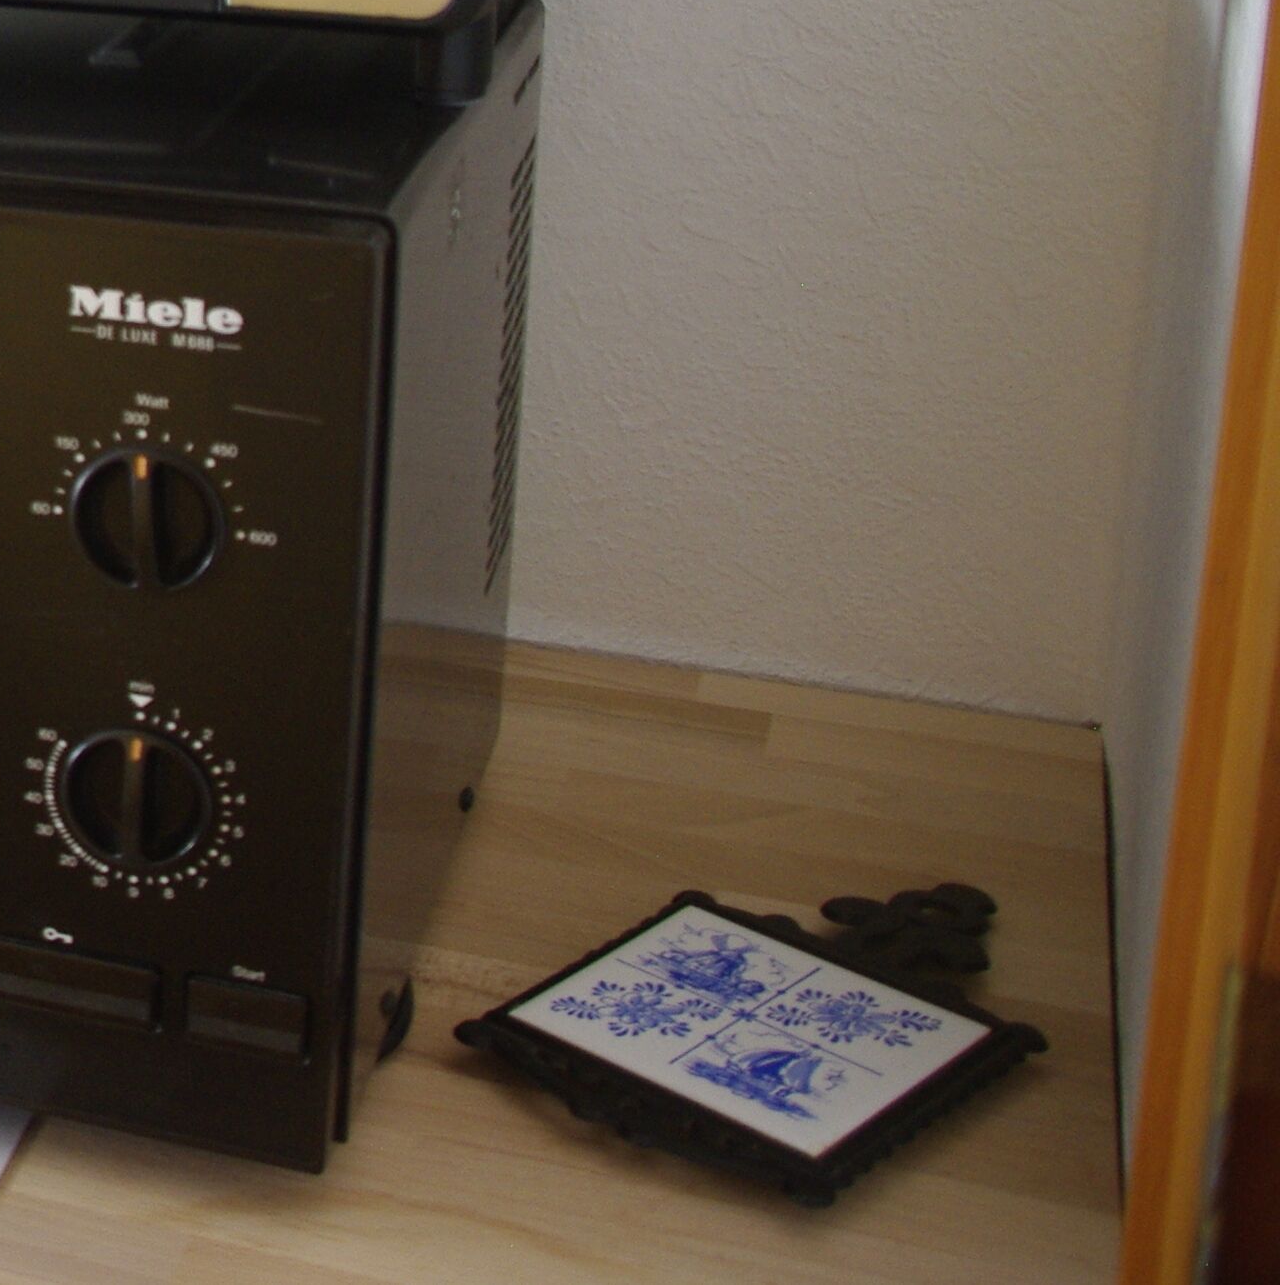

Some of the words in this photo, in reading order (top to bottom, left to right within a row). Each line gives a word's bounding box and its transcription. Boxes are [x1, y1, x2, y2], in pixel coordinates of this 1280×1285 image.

[69, 284, 244, 336] Miele
[95, 324, 114, 341] DE
[120, 327, 158, 346] LUXE
[135, 393, 170, 410] Watt
[122, 410, 151, 426] 300
[55, 435, 80, 451] 150
[210, 442, 239, 458] 450
[248, 530, 278, 546] 600
[202, 728, 214, 742] 2
[235, 793, 247, 806] 4
[92, 874, 109, 888] 10
[197, 876, 209, 888] 7
